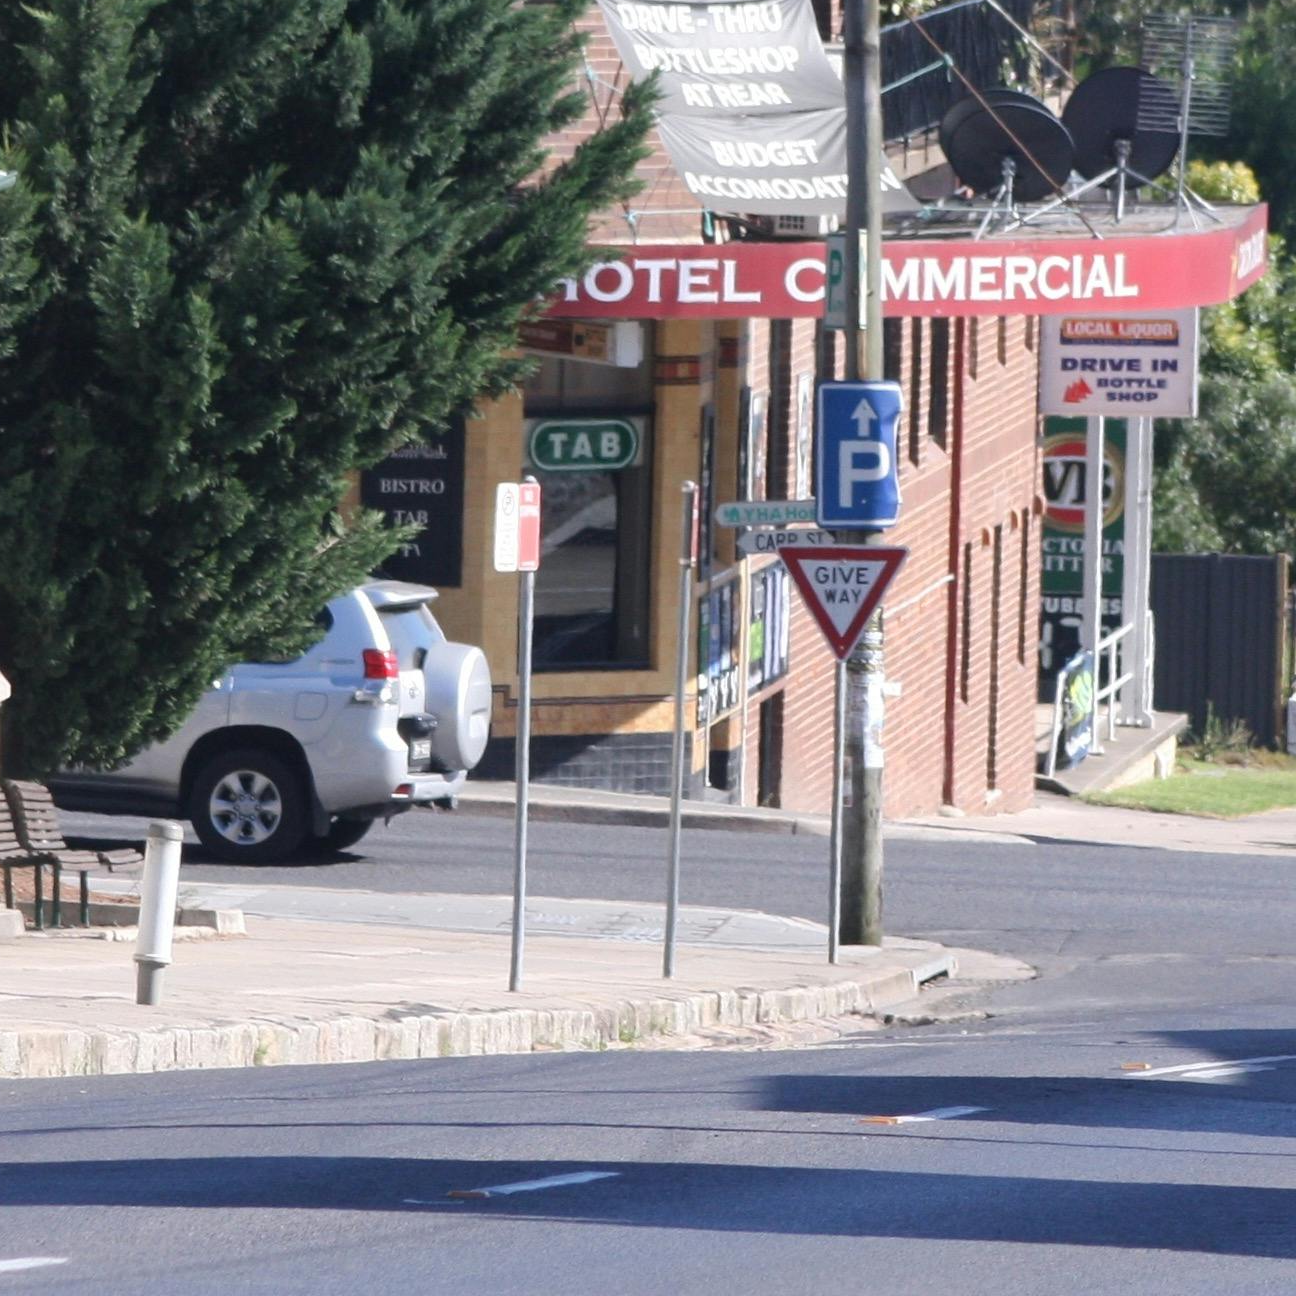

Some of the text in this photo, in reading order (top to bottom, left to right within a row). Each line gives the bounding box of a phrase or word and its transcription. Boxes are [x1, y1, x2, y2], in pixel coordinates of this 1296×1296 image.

[633, 44, 799, 75] BOTTLESHOP
[681, 82, 792, 108] AT REAR
[709, 139, 818, 168] BUDGET
[684, 168, 902, 201] ACCOMODATN
[784, 254, 1139, 303] CMMERCIAL
[1066, 321, 1113, 336] LOCAL
[1061, 358, 1178, 372] DRIVE IN
[1097, 378, 1167, 389] BOTTLE
[1106, 392, 1159, 402] SHOP
[548, 431, 622, 459] TAB
[839, 440, 890, 508] P
[380, 478, 445, 494] BISTRO
[393, 510, 429, 528] TAB
[744, 507, 782, 522] YHA
[1043, 538, 1124, 555] CTOIA
[1045, 556, 1114, 574] ITTR
[815, 567, 870, 585] GIVE
[824, 589, 862, 604] WAY
